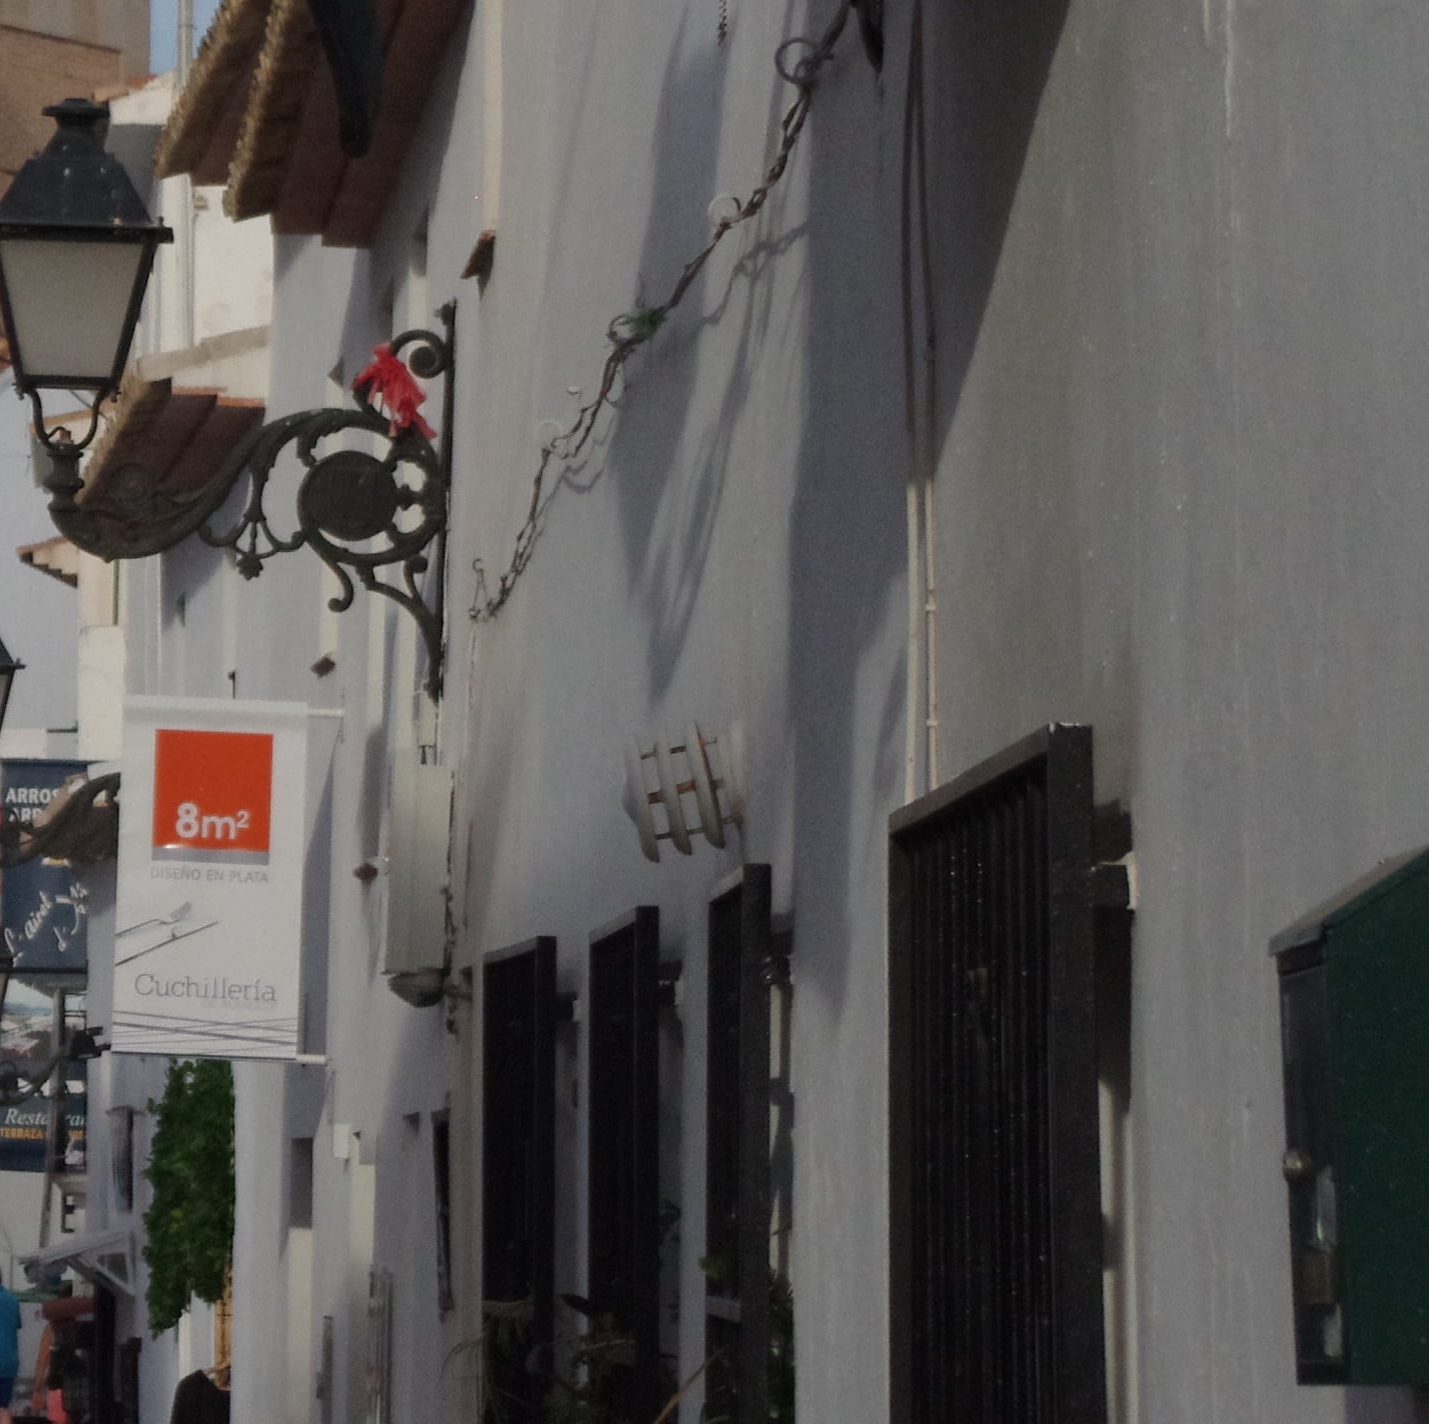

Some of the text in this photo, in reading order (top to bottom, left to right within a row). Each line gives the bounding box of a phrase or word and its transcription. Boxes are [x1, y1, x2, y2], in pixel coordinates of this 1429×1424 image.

[149, 865, 270, 884] DISEÑO EN PLATA
[134, 972, 277, 1003] Cuchillería
